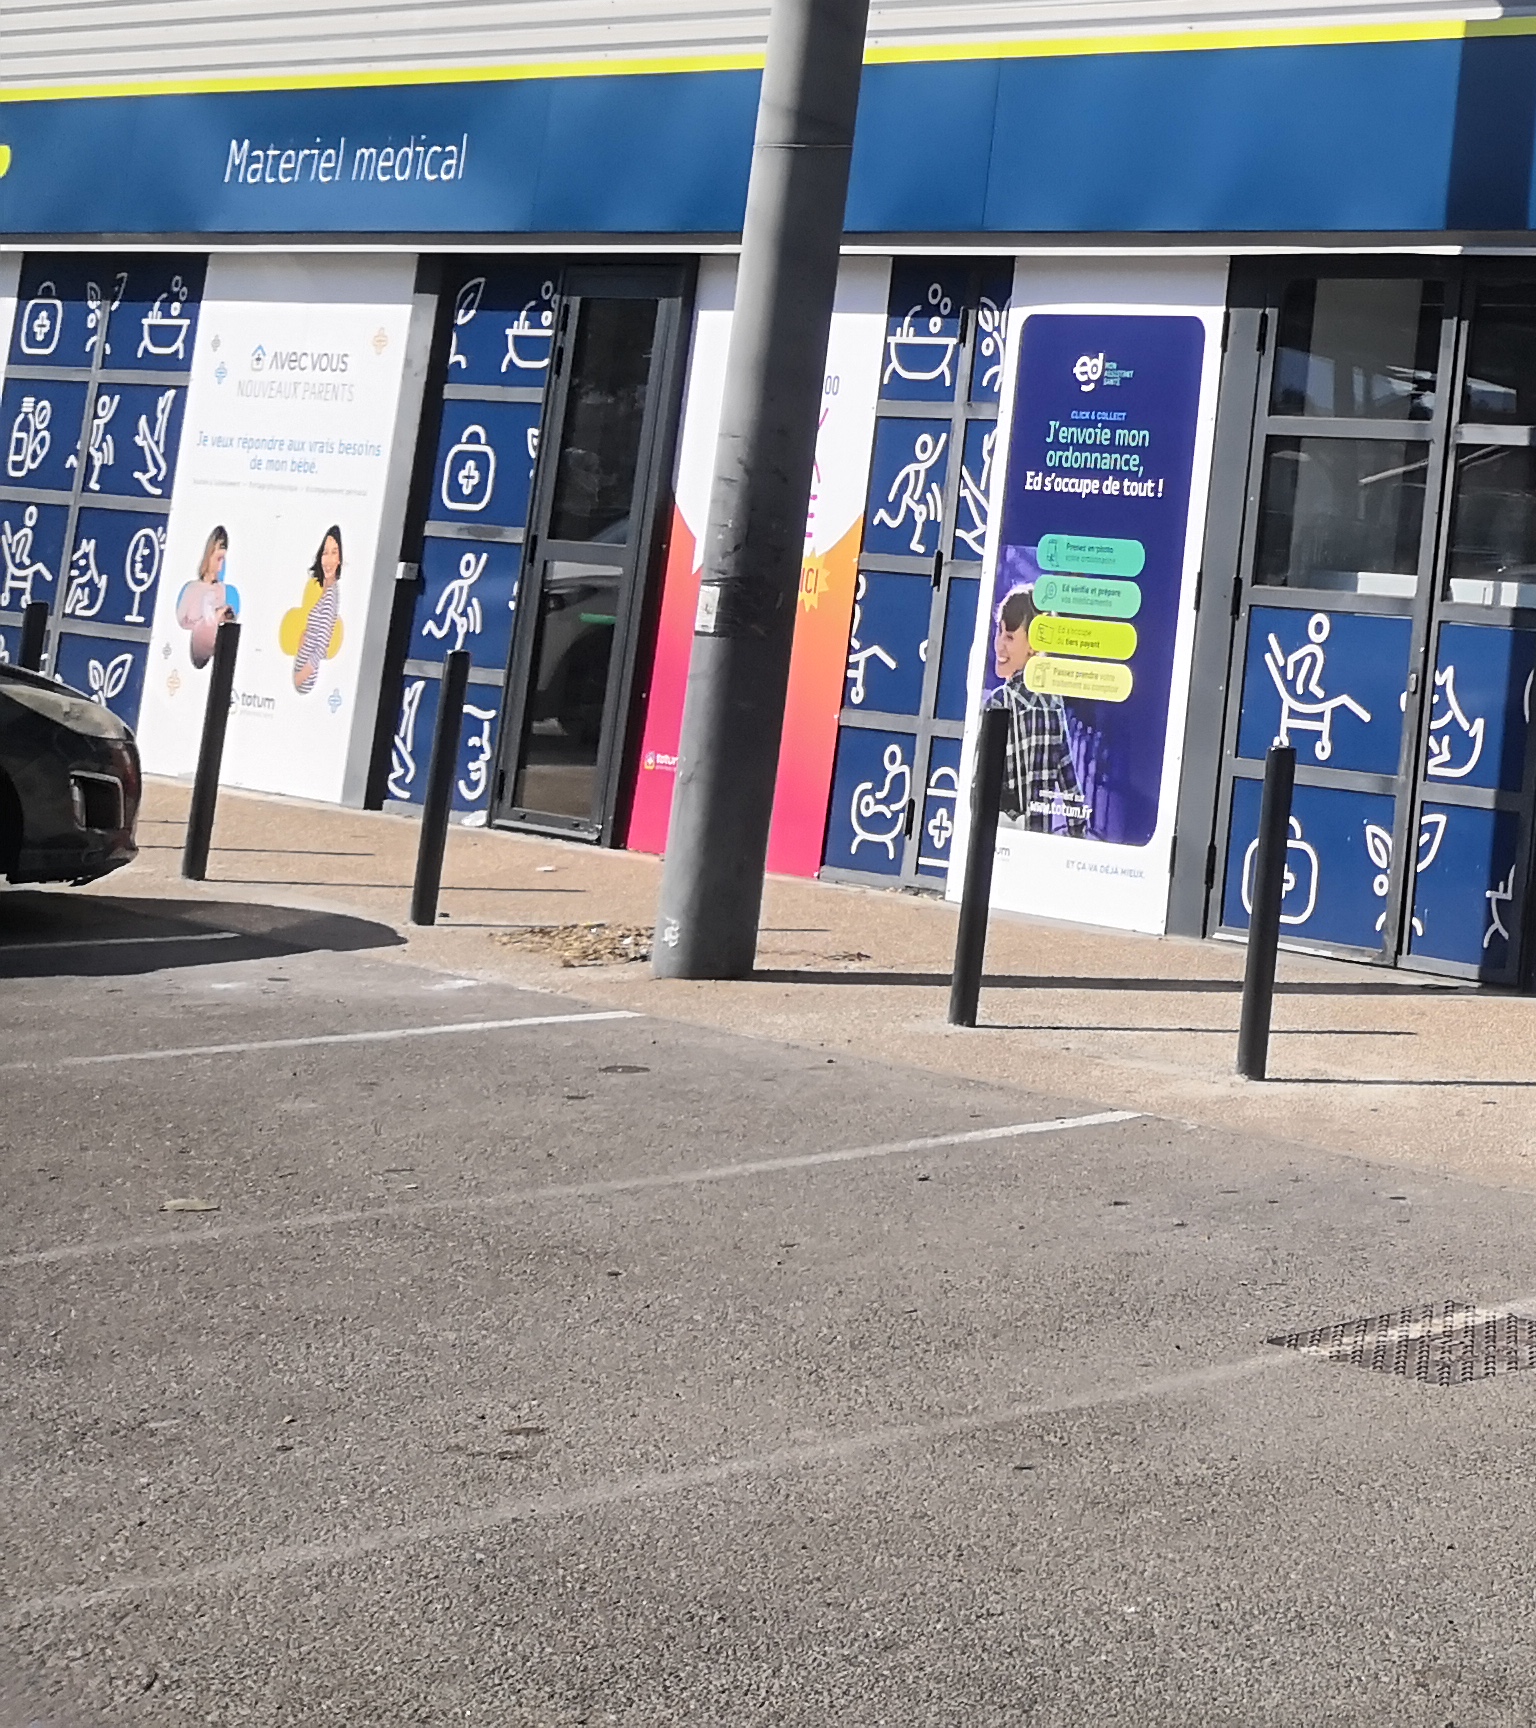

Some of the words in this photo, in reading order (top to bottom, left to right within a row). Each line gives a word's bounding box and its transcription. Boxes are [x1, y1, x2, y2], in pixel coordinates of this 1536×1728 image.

[237, 379, 300, 399] NOUVEAUX
[302, 382, 355, 402] PARENTS
[1097, 411, 1127, 421] COLLECT
[197, 431, 208, 447] Je
[211, 434, 234, 447] veux
[287, 438, 305, 452] aux
[309, 437, 334, 454] vrais
[338, 439, 381, 457] besoins
[1046, 420, 1111, 446] J'envoie
[1115, 427, 1150, 448] mon
[250, 455, 262, 471] de
[265, 459, 288, 472] mon
[1046, 446, 1145, 478] ordonnance,
[1025, 471, 1042, 491] Ed
[1044, 473, 1100, 499] s'occupe
[1102, 475, 1120, 495] de
[1123, 477, 1155, 498] tout
[800, 567, 819, 594] ICI
[1030, 801, 1092, 819] www.totum.fr
